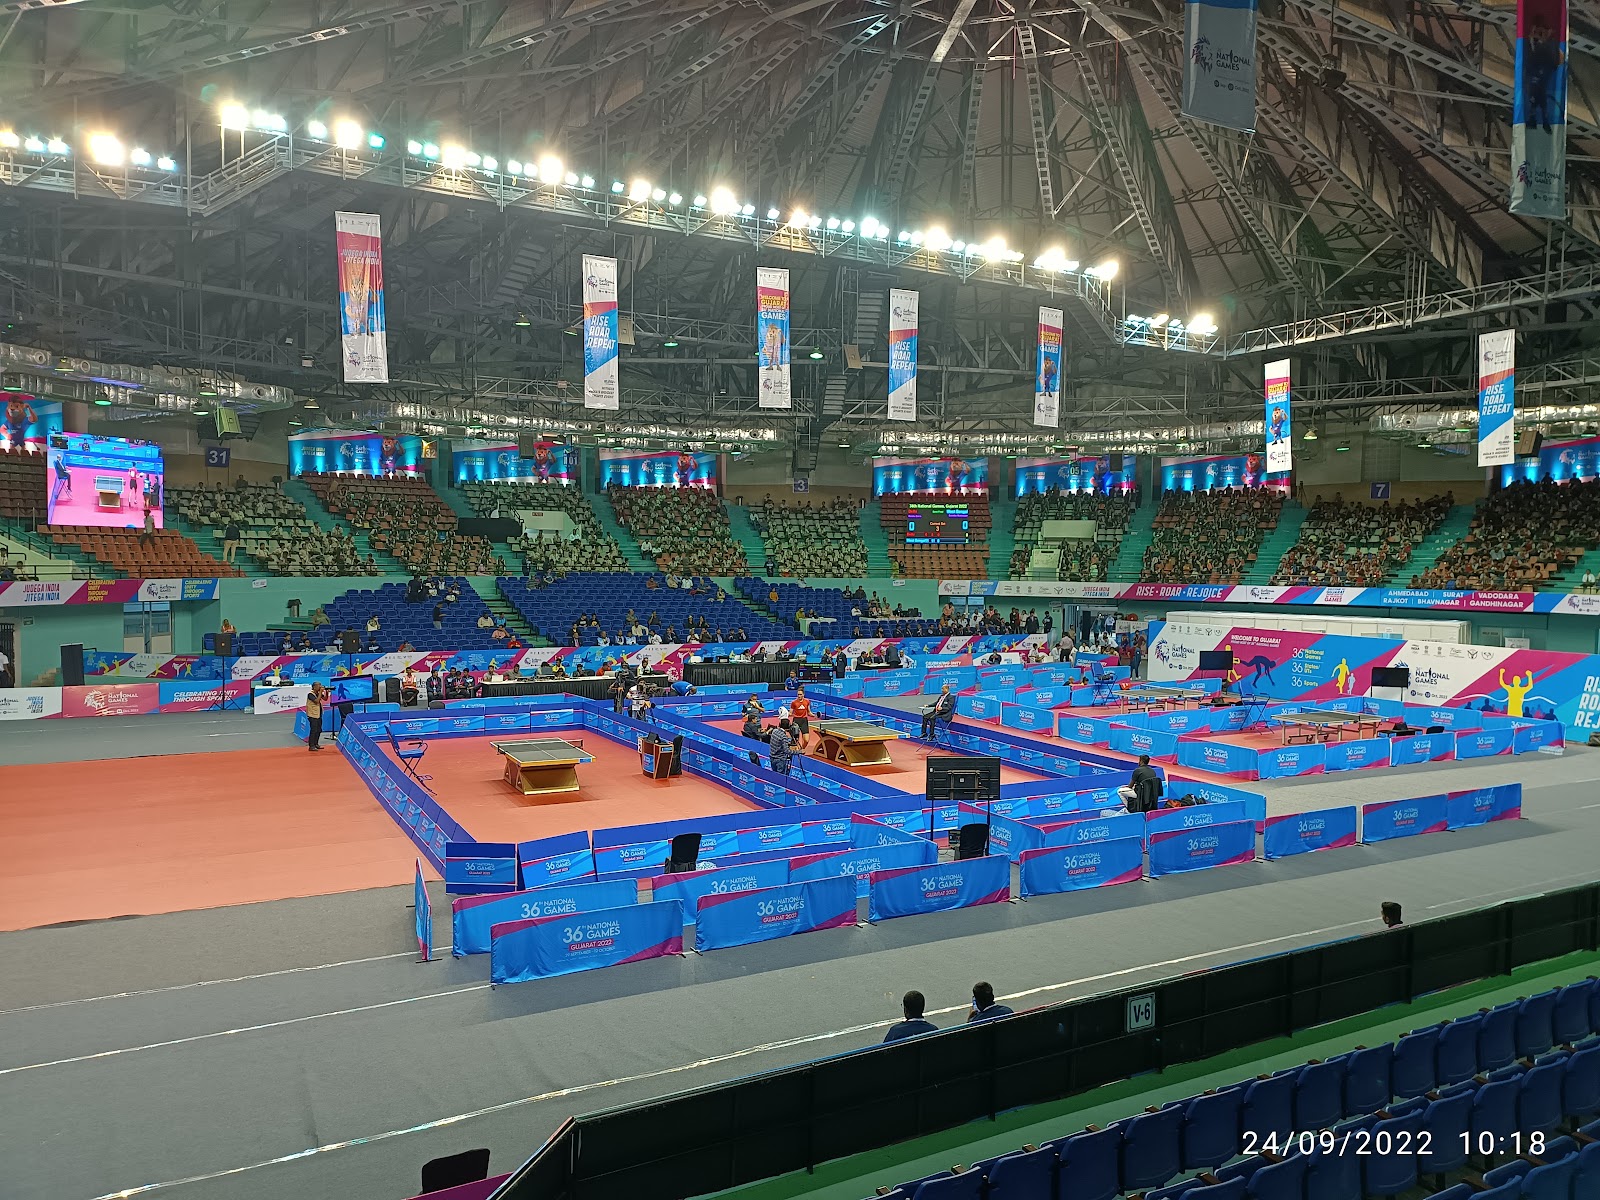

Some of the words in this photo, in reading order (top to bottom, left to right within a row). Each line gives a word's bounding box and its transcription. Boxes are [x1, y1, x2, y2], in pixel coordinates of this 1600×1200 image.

[1216, 51, 1250, 66] NATIONAL
[1216, 62, 1240, 71] GAMES
[1534, 168, 1561, 180] NATIONAL
[1534, 176, 1552, 185] GAMES
[590, 315, 609, 326] RISE
[761, 312, 786, 320] GAMES
[589, 326, 610, 338] ROAR
[588, 337, 616, 350] REPEAT
[895, 341, 910, 351] RISE
[1040, 346, 1058, 354] GAMES
[893, 350, 910, 361] ROAR
[891, 360, 916, 371] REPEAT
[1486, 384, 1504, 396] RISE
[1484, 394, 1505, 406] ROAR
[1482, 403, 1512, 416] REPEAT
[209, 450, 227, 464] 31
[798, 480, 806, 491] 3
[1376, 484, 1386, 497] 7
[909, 522, 915, 531] 0
[962, 521, 968, 530] 0
[23, 584, 44, 593] JUDEGA
[45, 584, 60, 592] INDIA
[1136, 586, 1154, 596] RISE
[1159, 586, 1181, 597] ROAR
[1186, 587, 1223, 599] REJOICE
[24, 593, 45, 602] JITEGA
[46, 592, 60, 600] INDIA
[1172, 644, 1195, 654] NATIONAL
[1292, 662, 1303, 673] 36
[1416, 668, 1450, 679] NATIONAL
[1291, 676, 1302, 687] 36
[1584, 676, 1600, 692] RI
[1579, 693, 1600, 711] RO
[857, 858, 880, 866] NATIONAL
[1079, 857, 1101, 866] GAMES
[856, 863, 881, 873] GAMES
[730, 875, 757, 884] NATIONAL
[939, 873, 962, 881] NATIONAL
[730, 881, 758, 891] GAMES
[938, 879, 963, 889] GAMES
[544, 898, 575, 906] NATIONAL
[777, 895, 804, 904] NATIONAL
[544, 904, 577, 914] GAMES
[777, 901, 804, 912] GAMES
[763, 915, 784, 923] GUJARAT
[587, 920, 620, 930] NATIONAL
[587, 927, 620, 939] GAMES
[571, 942, 596, 950] GUJARAT
